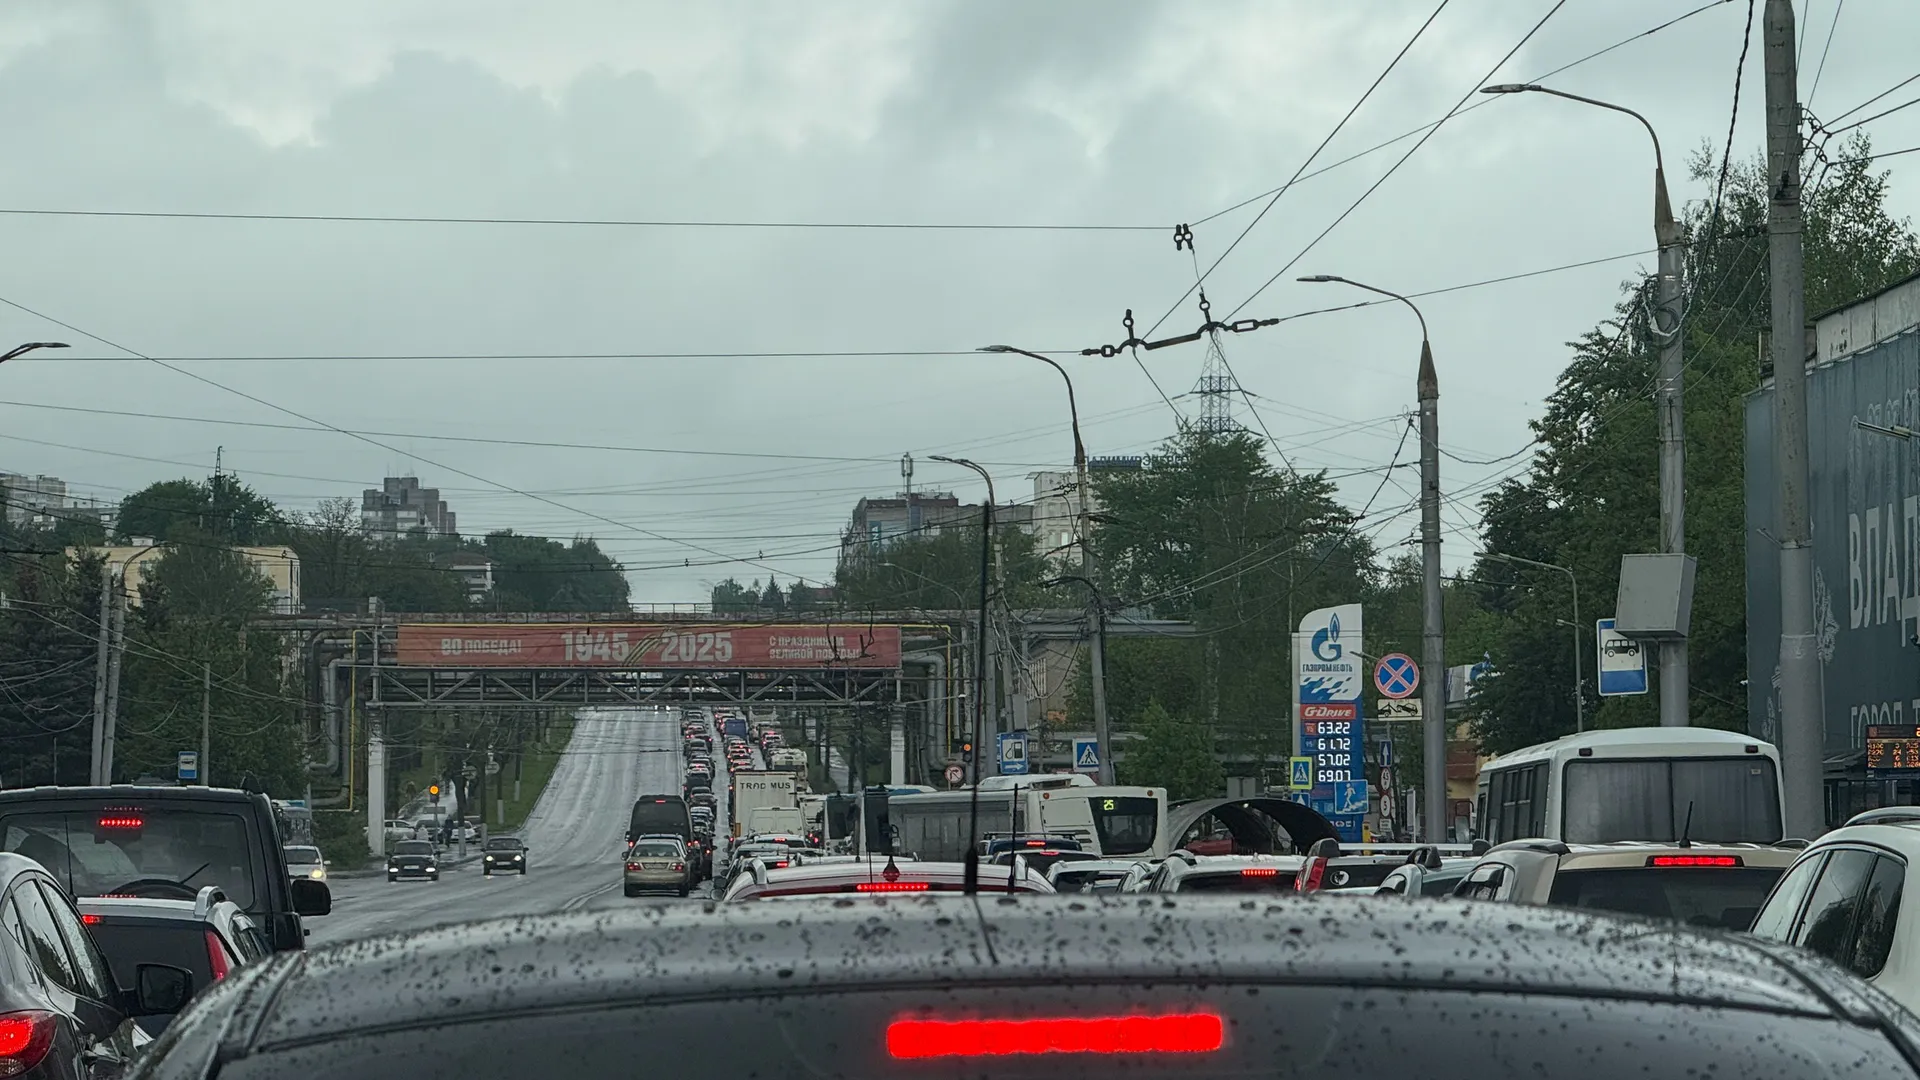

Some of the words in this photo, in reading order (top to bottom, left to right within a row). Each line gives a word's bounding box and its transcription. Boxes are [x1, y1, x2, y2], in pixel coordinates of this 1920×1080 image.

[561, 631, 629, 662] 1945
[660, 632, 732, 662] 2025
[769, 636, 776, 646] С
[464, 639, 522, 656] ПОБЕДА!
[769, 647, 813, 659] ВЕЛИКОЙ
[1302, 664, 1353, 673] ГАЗПРОМНЕФТЬ
[1318, 722, 1351, 734] 63.22
[1318, 738, 1351, 750] 61.72
[1318, 754, 1351, 766] 57.02
[1318, 770, 1351, 782] 69.07
[1103, 799, 1114, 810] 25
